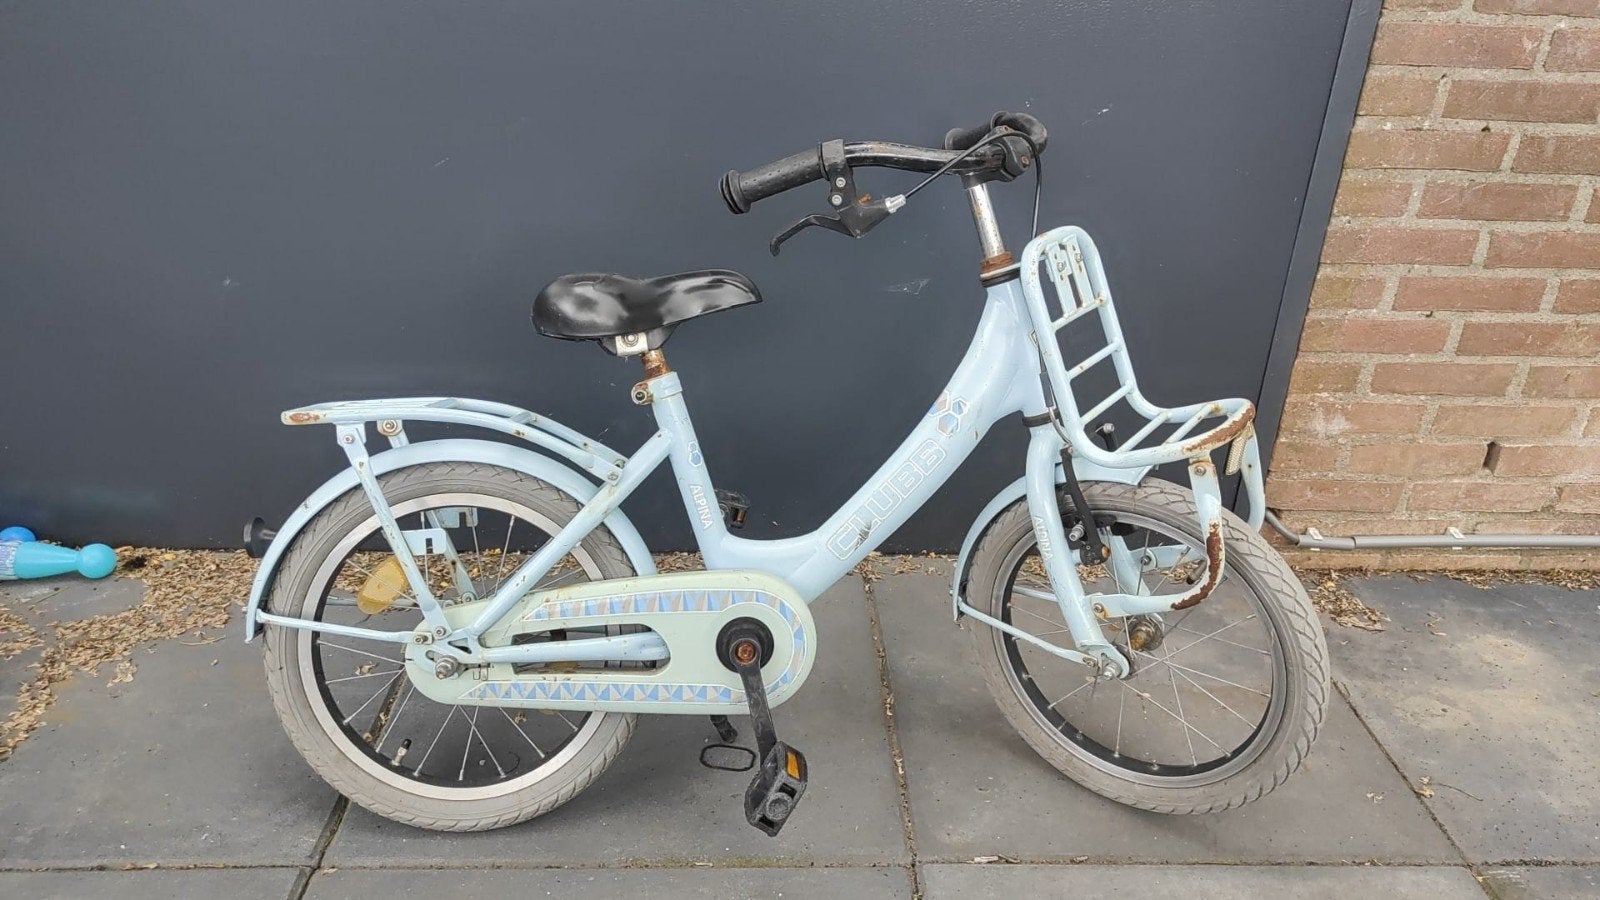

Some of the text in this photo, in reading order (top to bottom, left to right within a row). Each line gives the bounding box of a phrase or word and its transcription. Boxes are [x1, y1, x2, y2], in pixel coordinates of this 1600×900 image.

[689, 484, 714, 530] ALPINA
[826, 438, 946, 560] CLUBB
[1033, 516, 1054, 561] ALPINA
